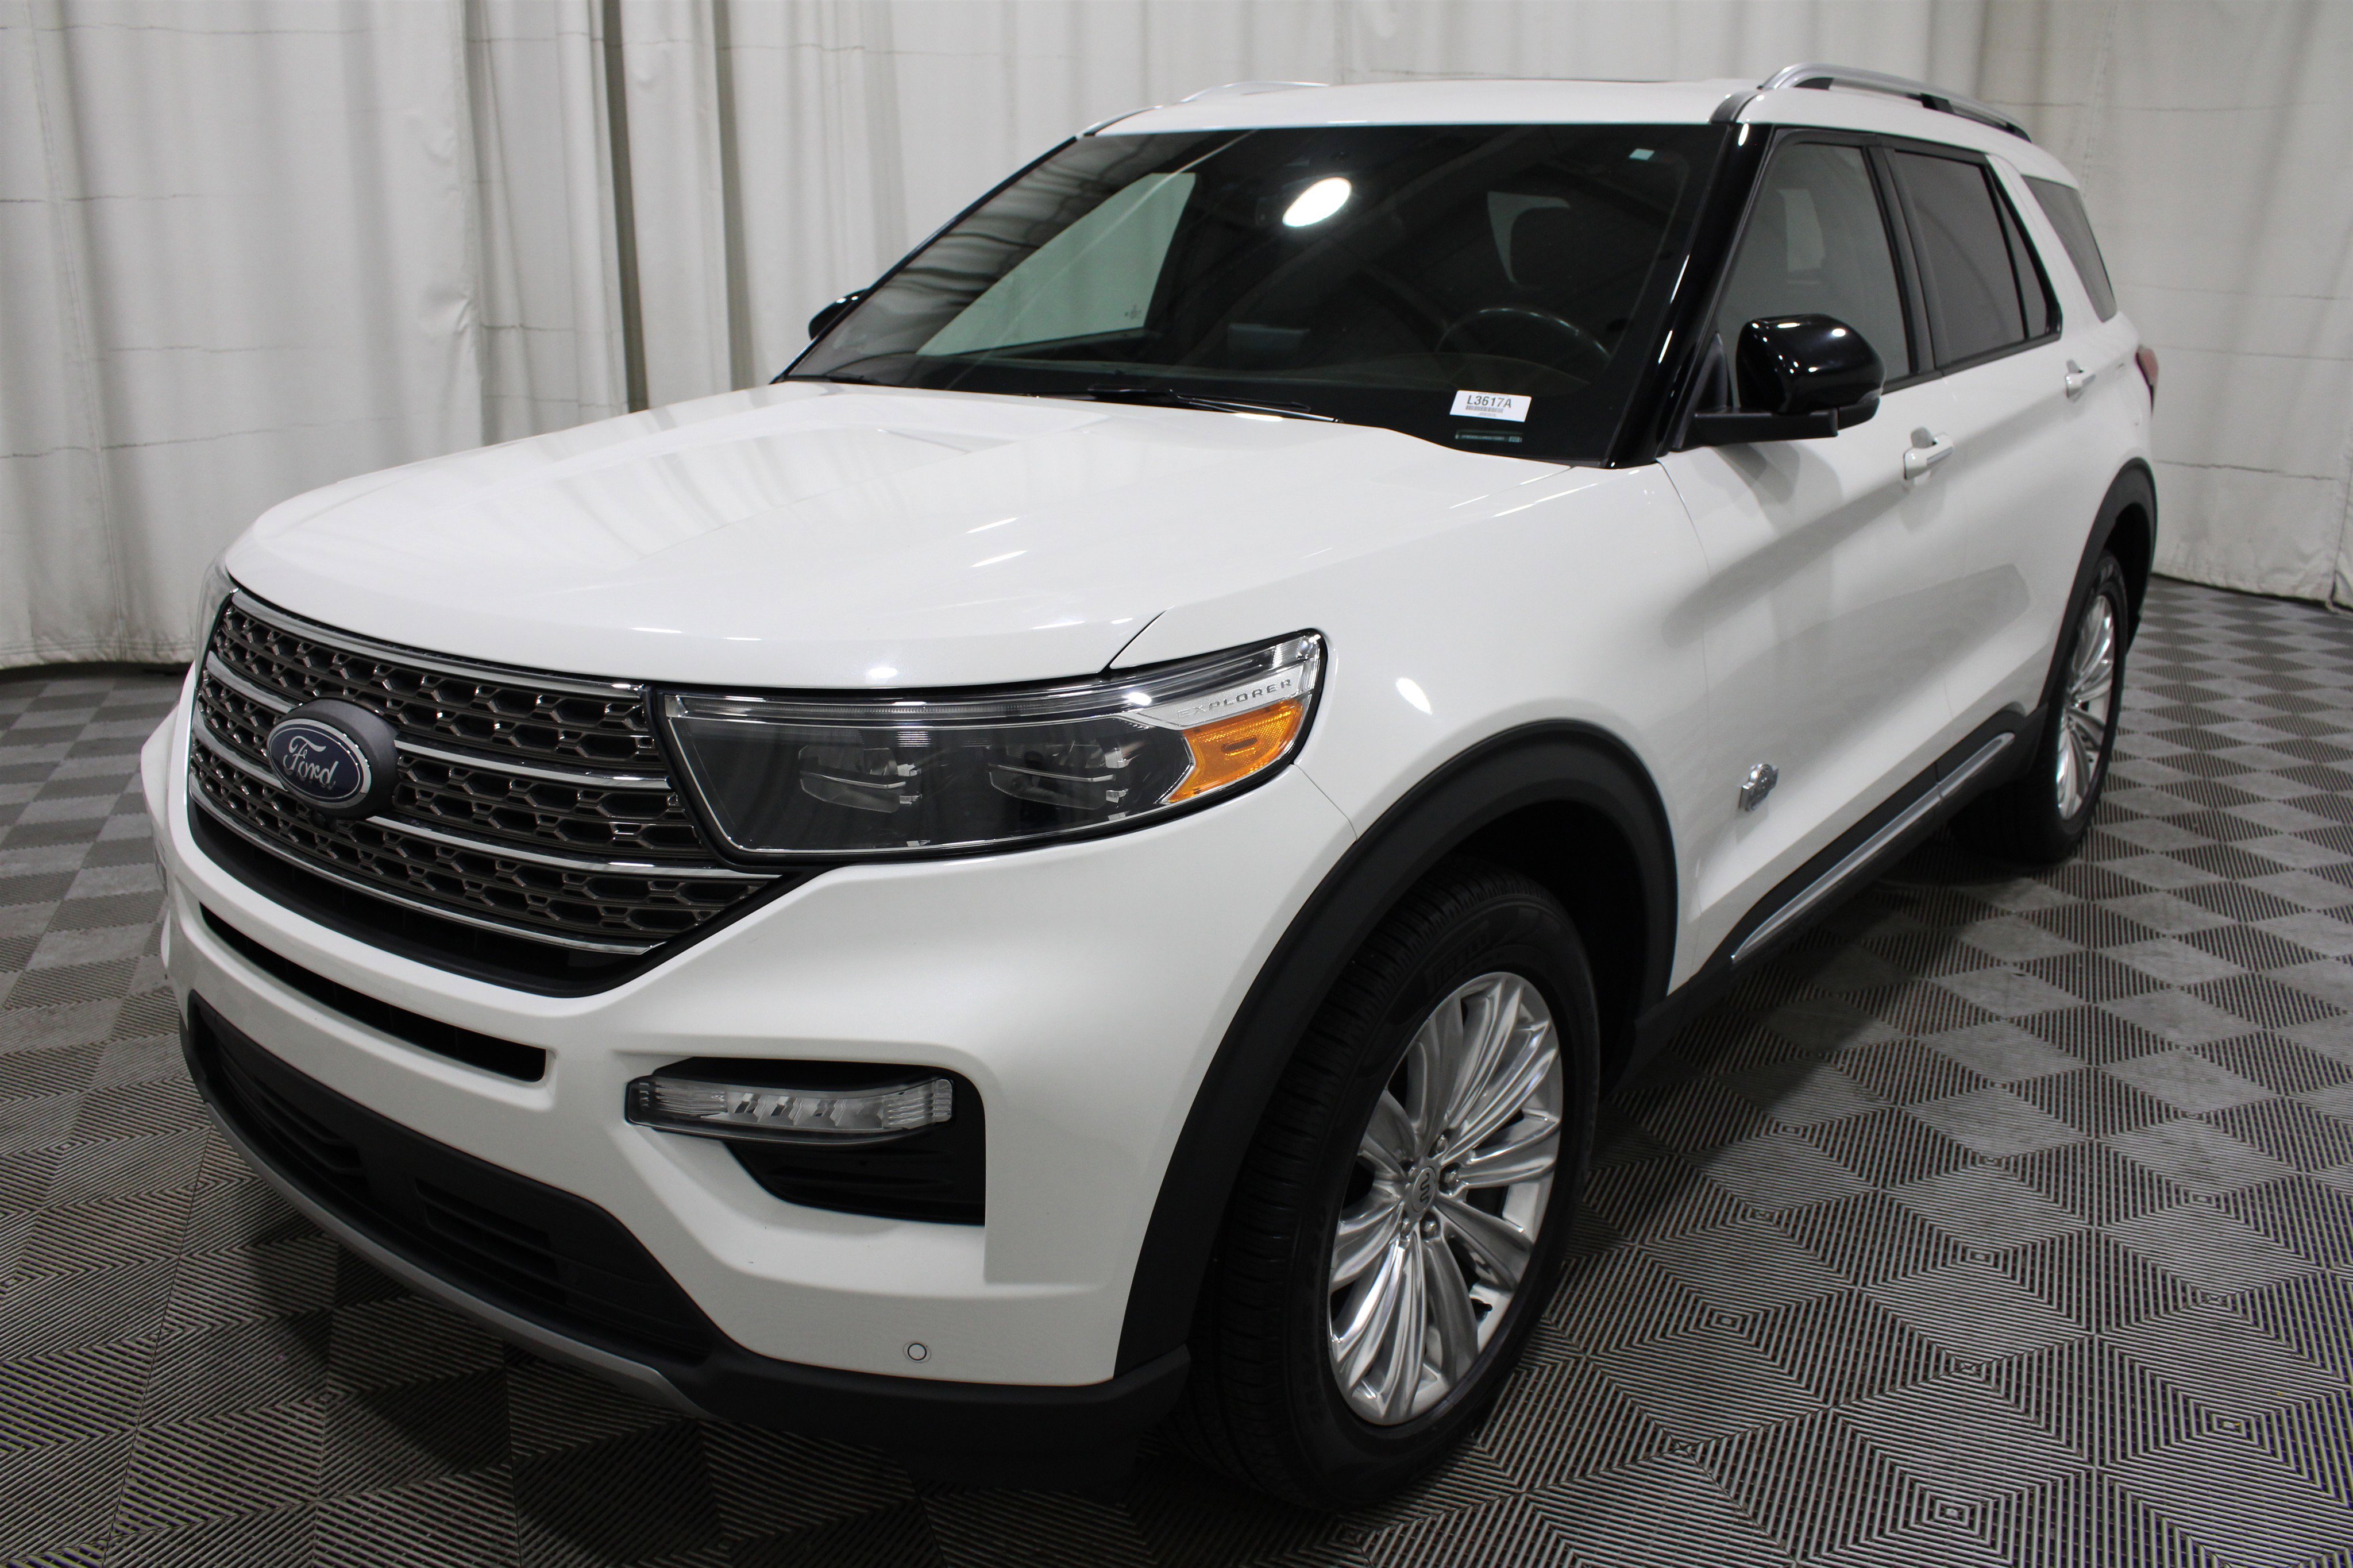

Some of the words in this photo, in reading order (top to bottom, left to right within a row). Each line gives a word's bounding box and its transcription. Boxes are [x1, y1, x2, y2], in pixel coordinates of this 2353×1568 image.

[1467, 395, 1512, 408] L3617A
[1178, 679, 1291, 718] EXPLORER
[283, 735, 338, 790] Ford
